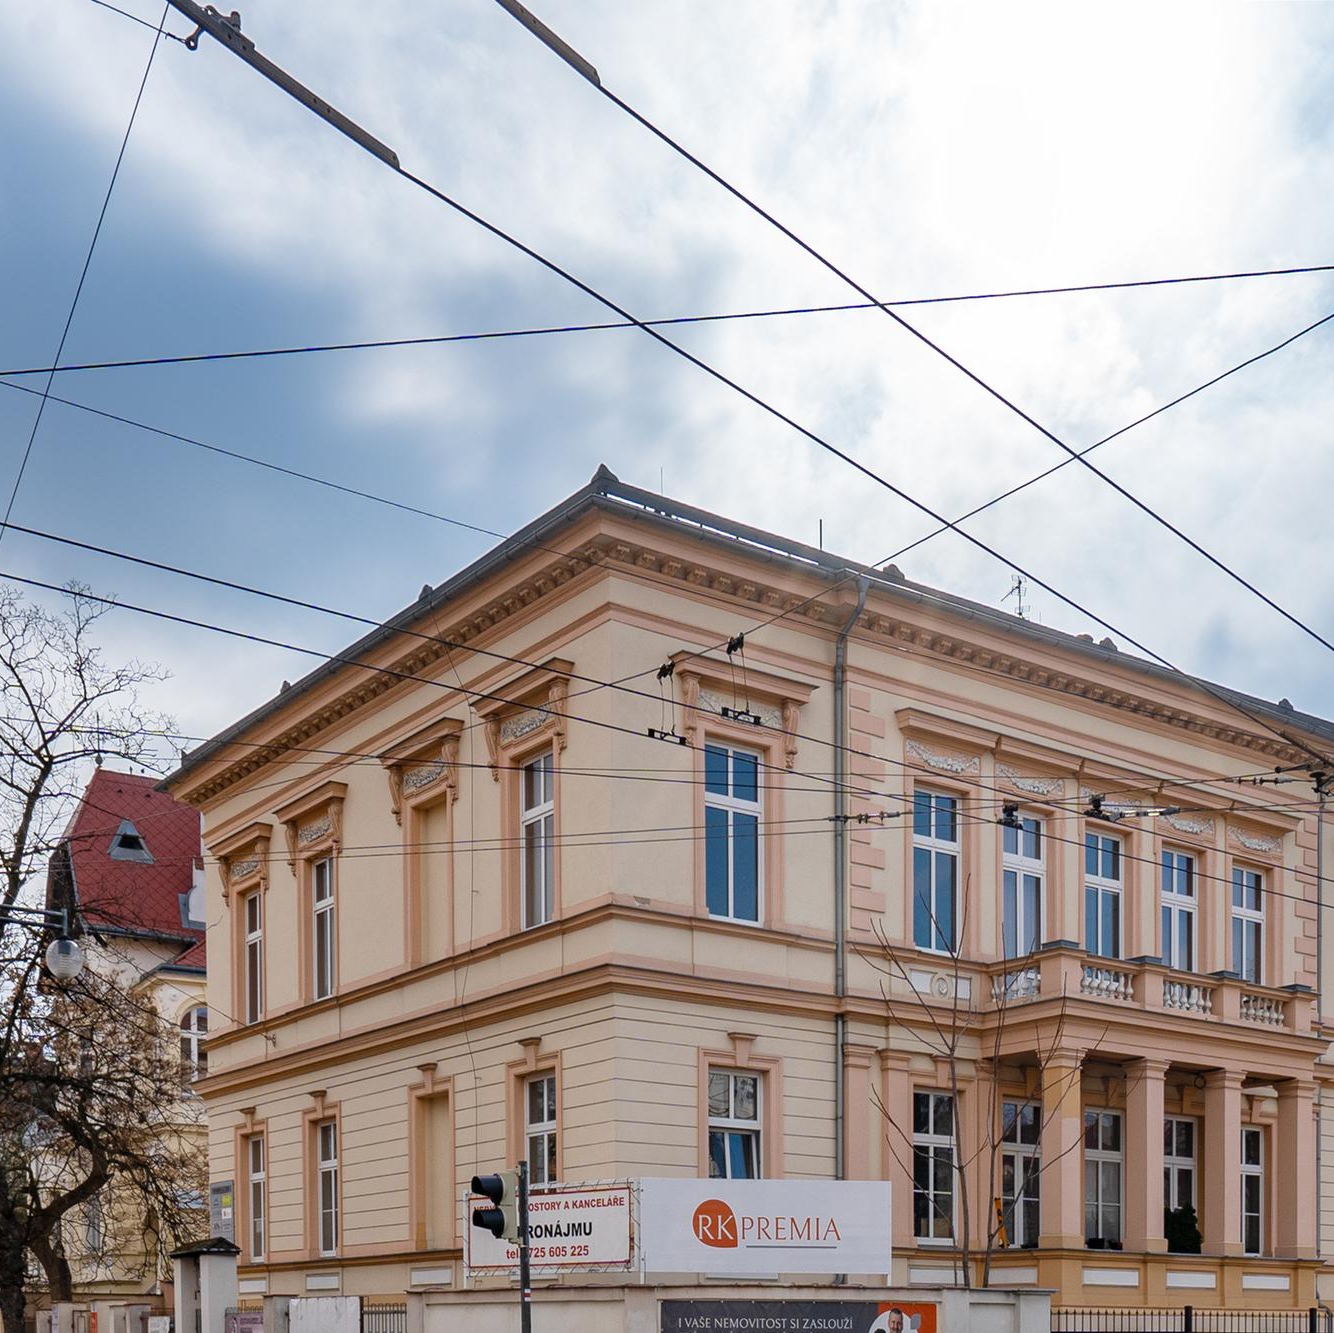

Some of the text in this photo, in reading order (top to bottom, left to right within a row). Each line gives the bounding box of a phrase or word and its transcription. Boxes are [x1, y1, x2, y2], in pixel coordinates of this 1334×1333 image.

[528, 1196, 625, 1212] OSTORY A KANCELÁŘE
[518, 1219, 593, 1239] RONÁJMU
[698, 1214, 841, 1241] RK PREMIA
[529, 1247, 546, 1258] 725
[549, 1245, 567, 1257] 605
[570, 1245, 589, 1257] 225
[678, 1316, 853, 1329] I VAŠE NEMOVITOST SI ZASLOUŽÍ
